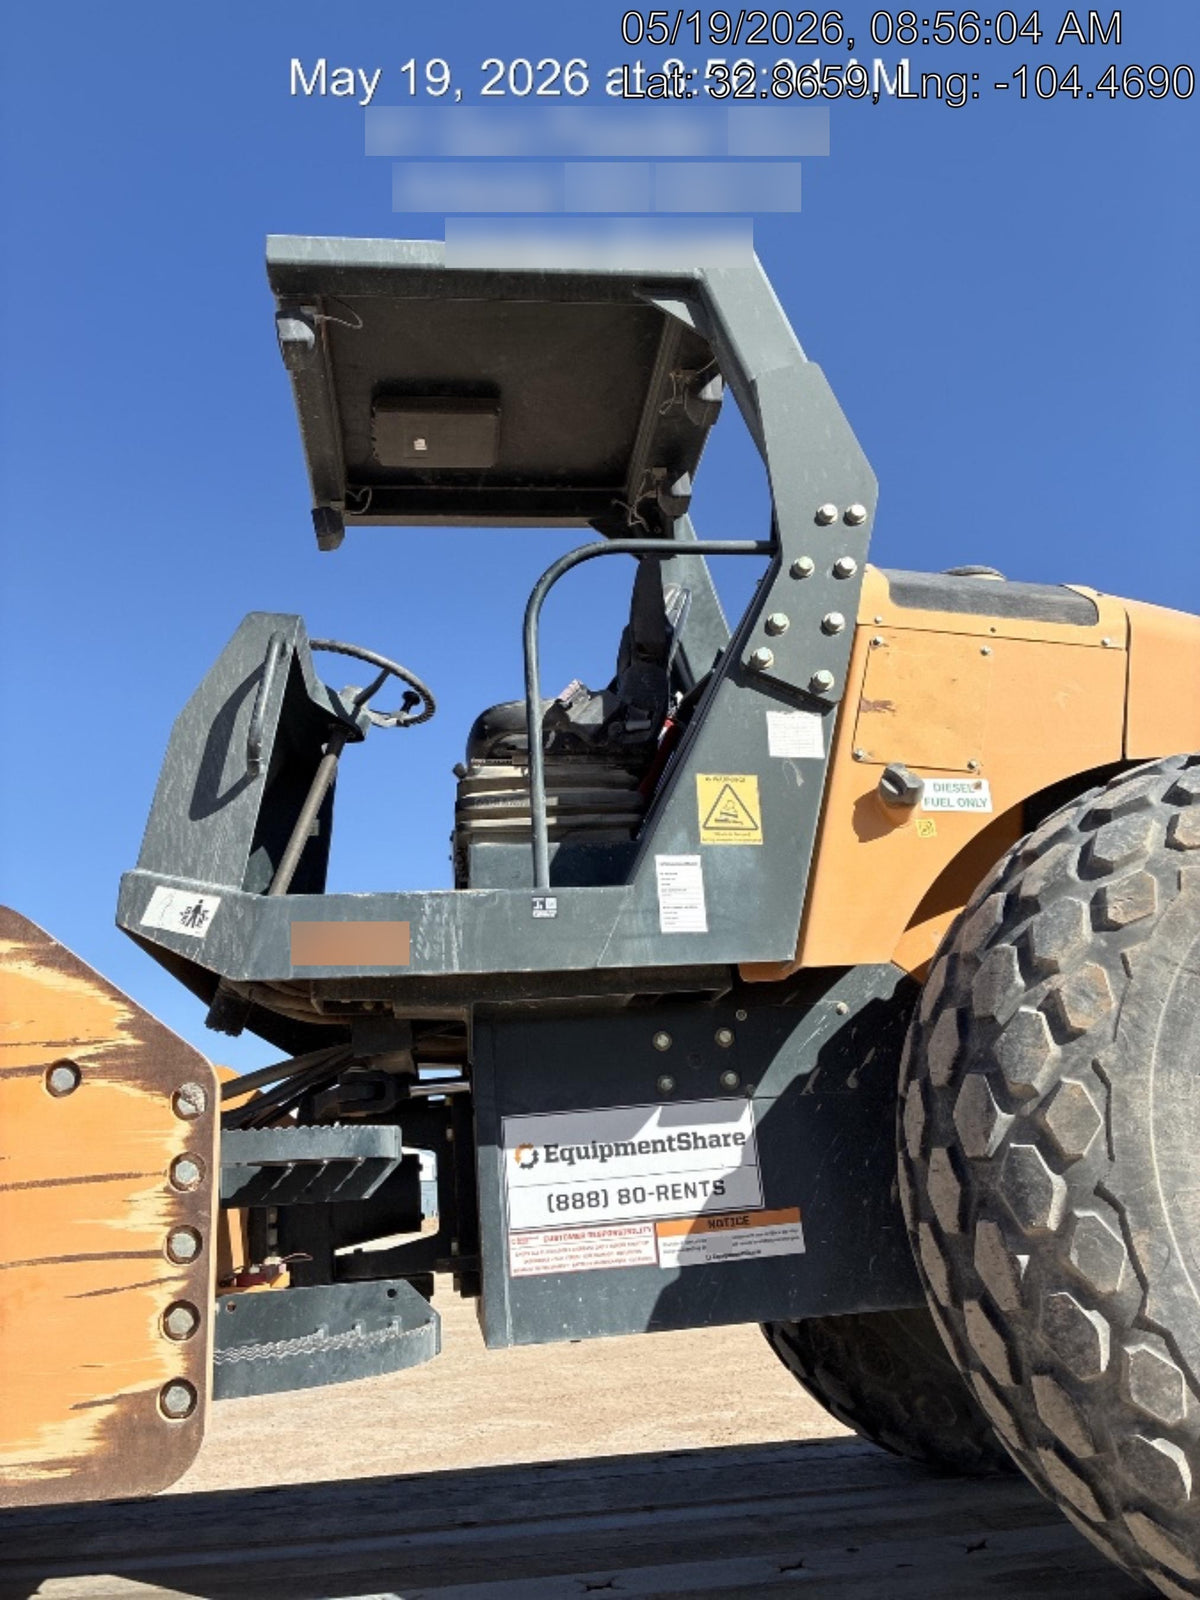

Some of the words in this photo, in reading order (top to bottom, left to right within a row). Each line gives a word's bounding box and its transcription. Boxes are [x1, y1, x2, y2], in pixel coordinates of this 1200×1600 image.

[932, 782, 975, 794] DIESEL
[923, 797, 955, 808] FUEL
[957, 797, 988, 809] ONLY
[543, 1130, 747, 1166] EquipmentShare
[547, 1188, 609, 1213] (888)
[617, 1179, 726, 1206] 80-RENTS
[707, 1215, 751, 1229] NOTICE
